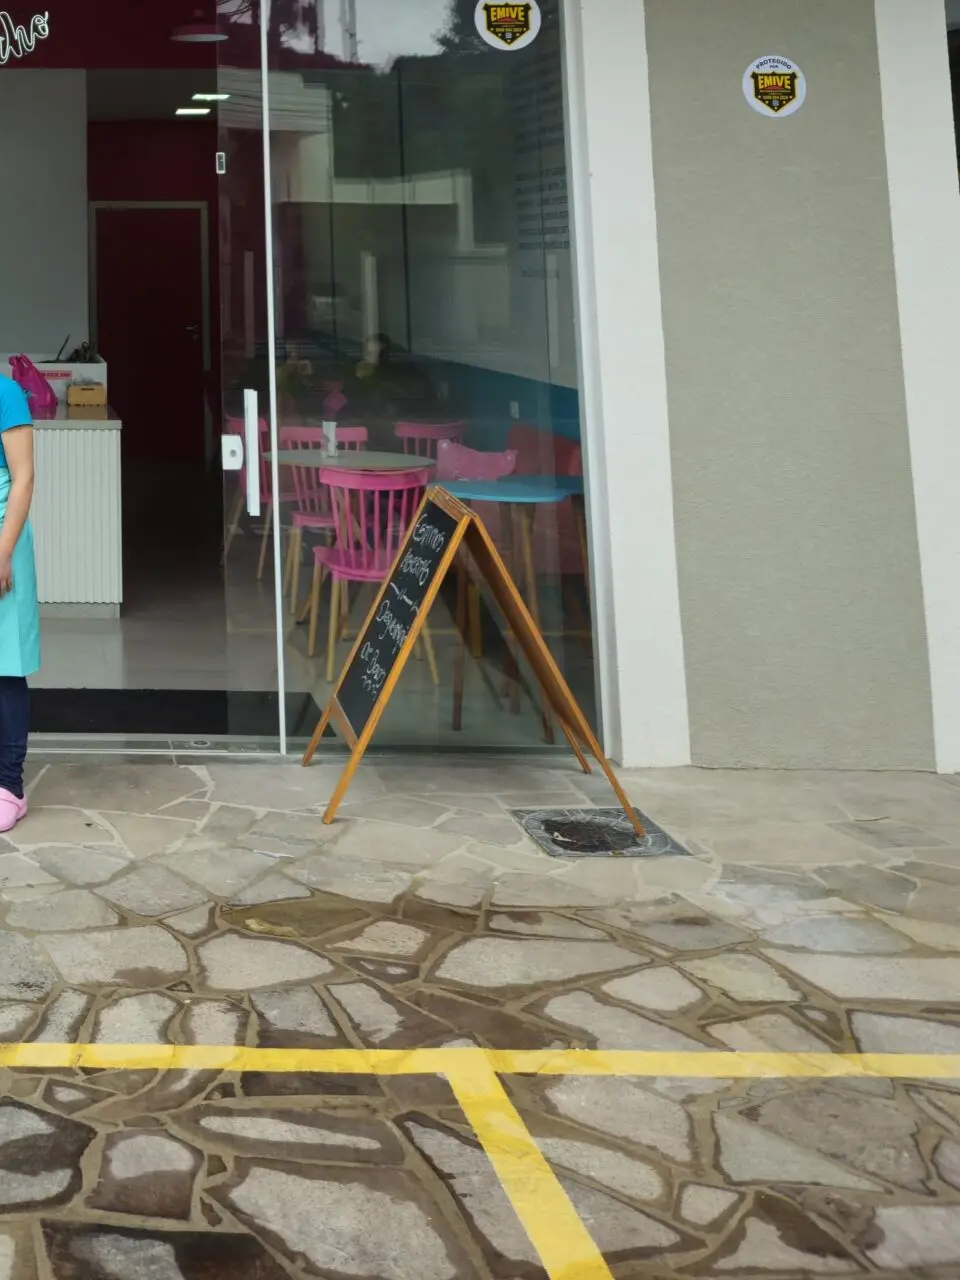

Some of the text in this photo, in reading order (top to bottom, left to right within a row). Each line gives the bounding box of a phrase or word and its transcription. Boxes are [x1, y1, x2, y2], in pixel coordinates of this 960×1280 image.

[491, 7, 525, 21] EMIVE
[756, 58, 792, 69] PROTEGIDO
[758, 75, 791, 89] EMIVE
